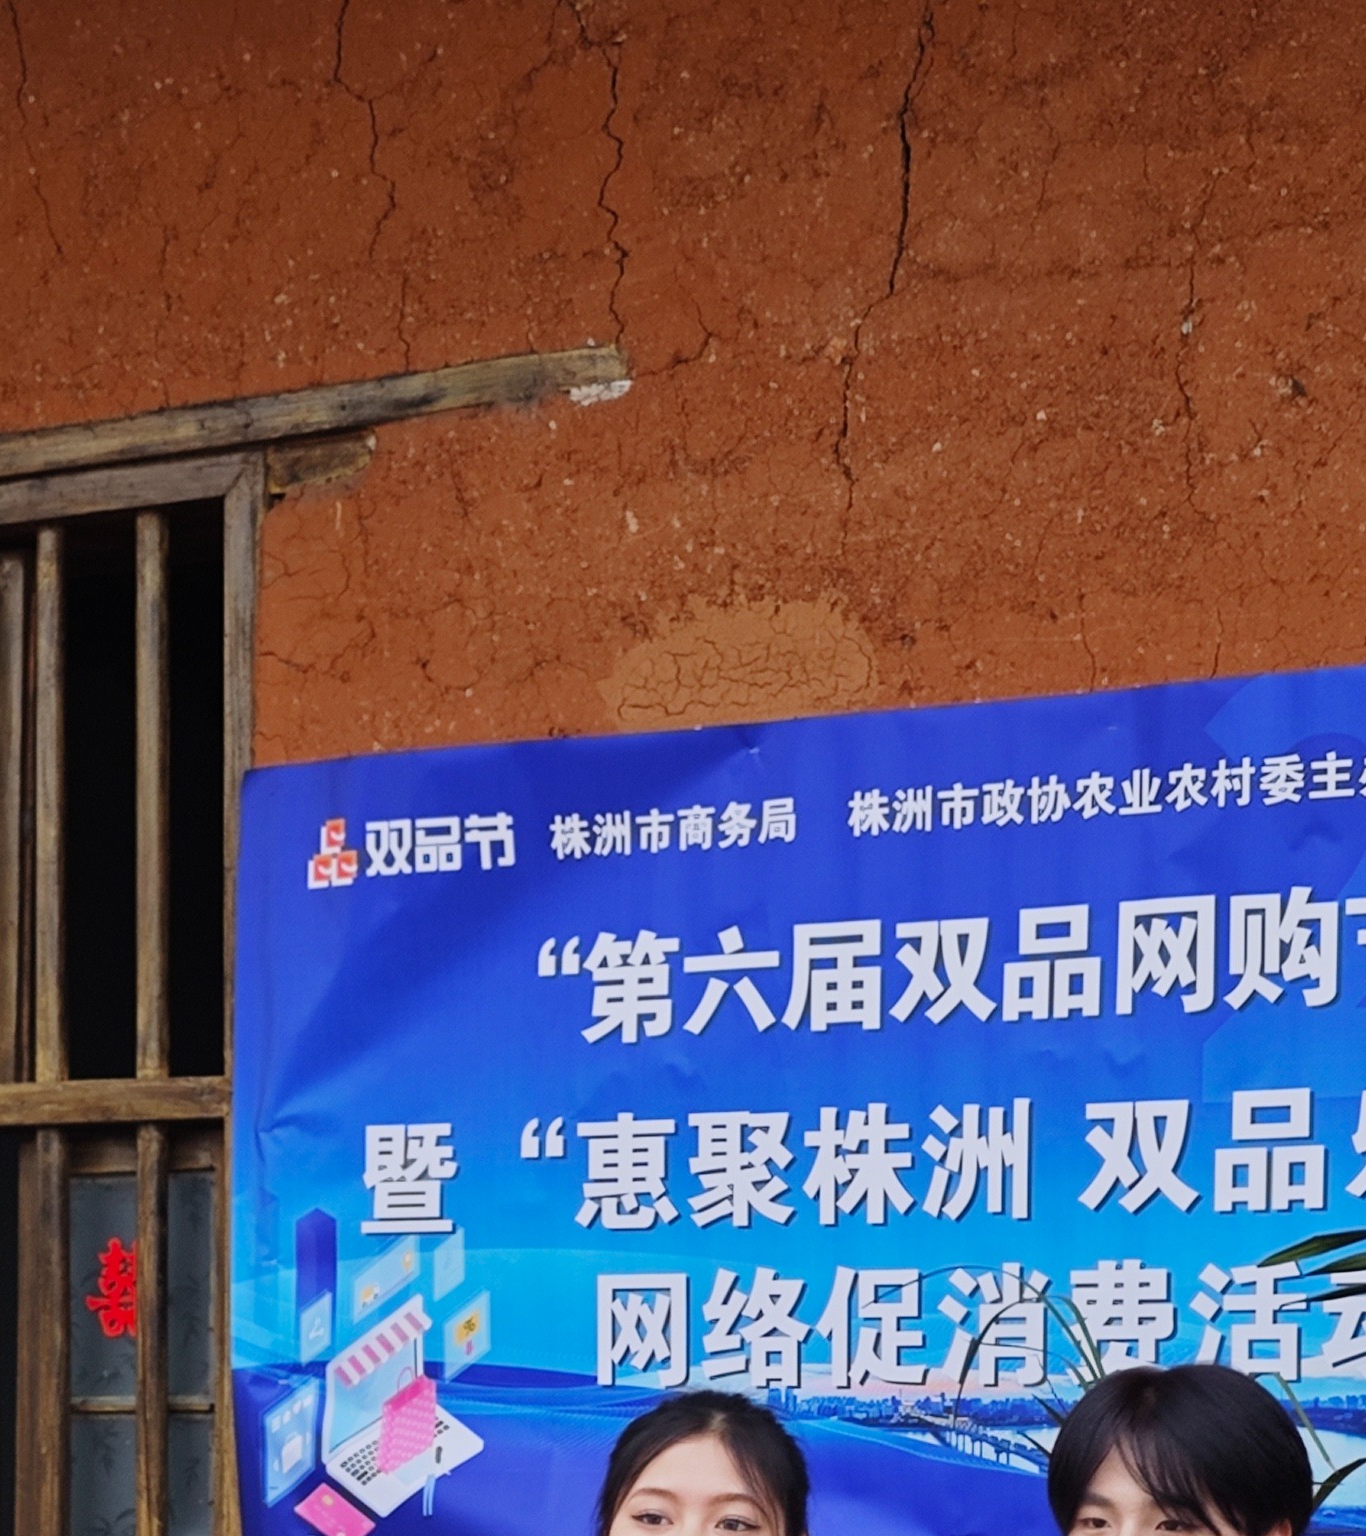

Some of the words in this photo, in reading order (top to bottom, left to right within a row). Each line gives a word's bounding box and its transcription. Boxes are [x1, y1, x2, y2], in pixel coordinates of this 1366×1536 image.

[365, 812, 516, 877] 双品节
[549, 797, 796, 860] 株洲市商务局
[361, 1122, 458, 1233] 暨
[520, 1098, 1029, 1230] “惠聚株洲
